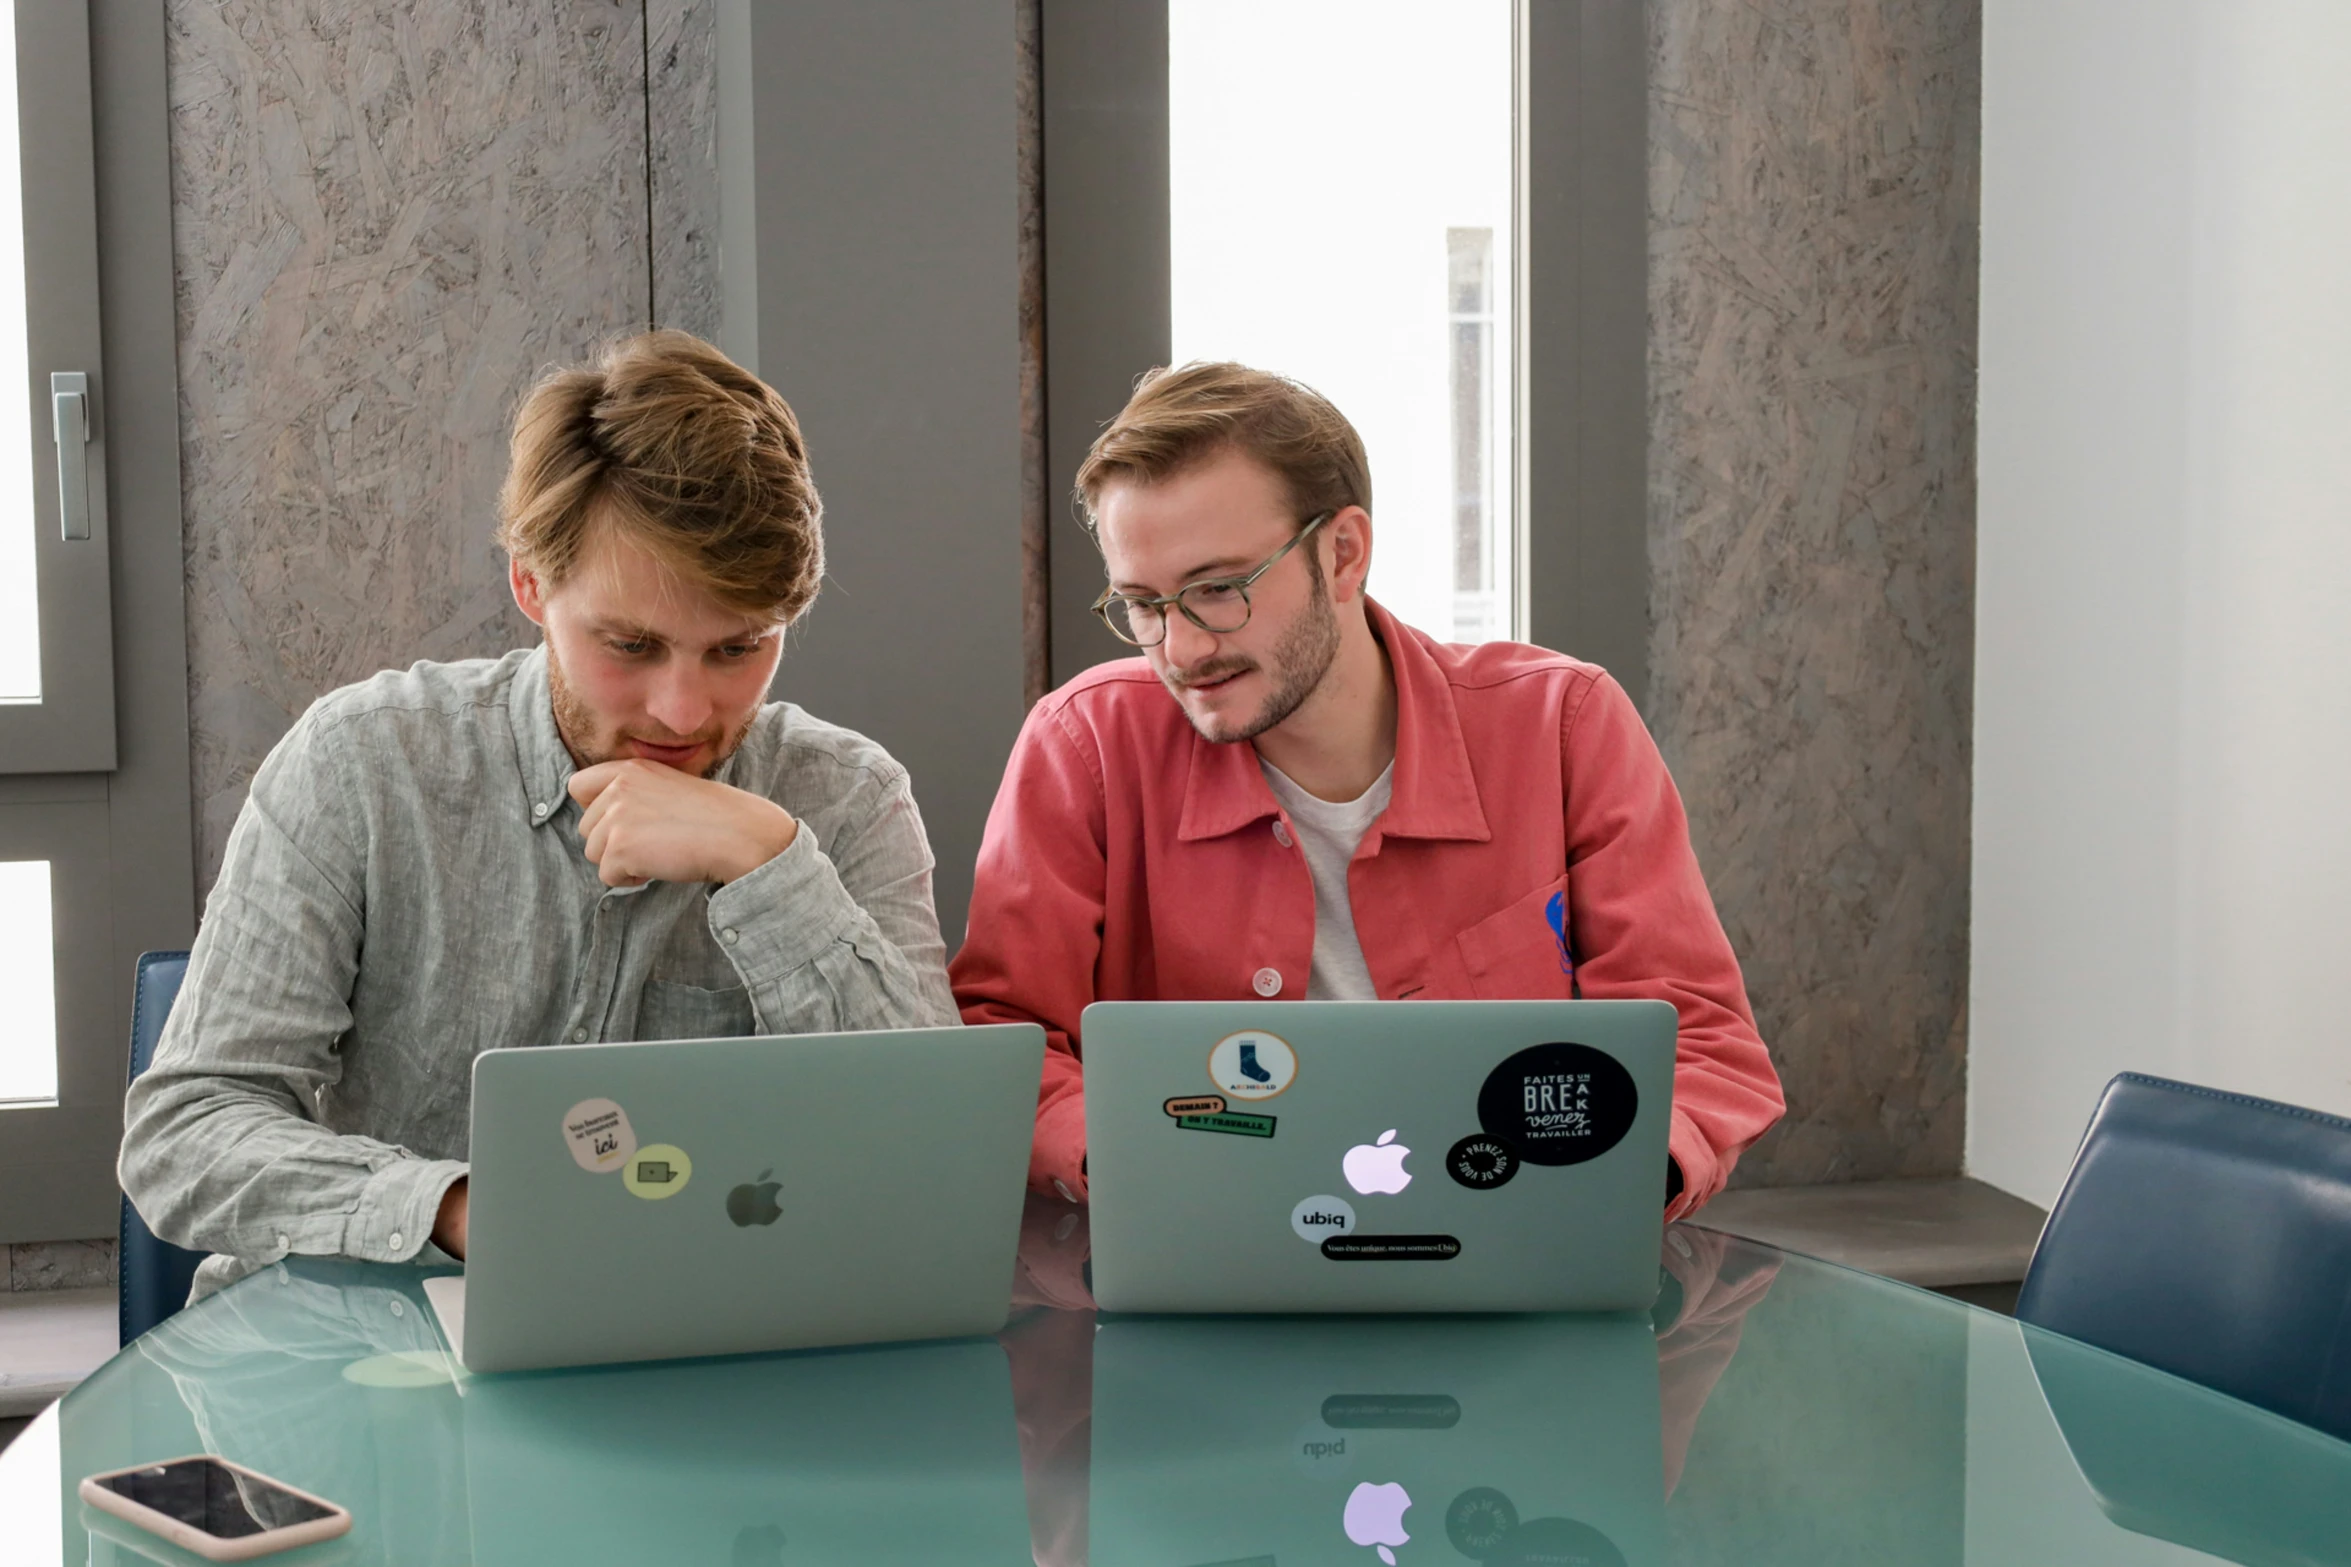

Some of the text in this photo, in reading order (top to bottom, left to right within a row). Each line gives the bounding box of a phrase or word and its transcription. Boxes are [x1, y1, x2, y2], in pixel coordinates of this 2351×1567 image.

[1524, 1073, 1591, 1085] FAITES UN
[1172, 1103, 1211, 1112] DEMAIN
[1525, 1112, 1591, 1130] venez
[1526, 1129, 1591, 1139] TRAVAILLER
[594, 1133, 618, 1155] ici
[1459, 1142, 1507, 1181] PRENEZ SOIN DE VOUS
[1303, 1212, 1345, 1228] ubiq
[1327, 1244, 1345, 1252] Vous
